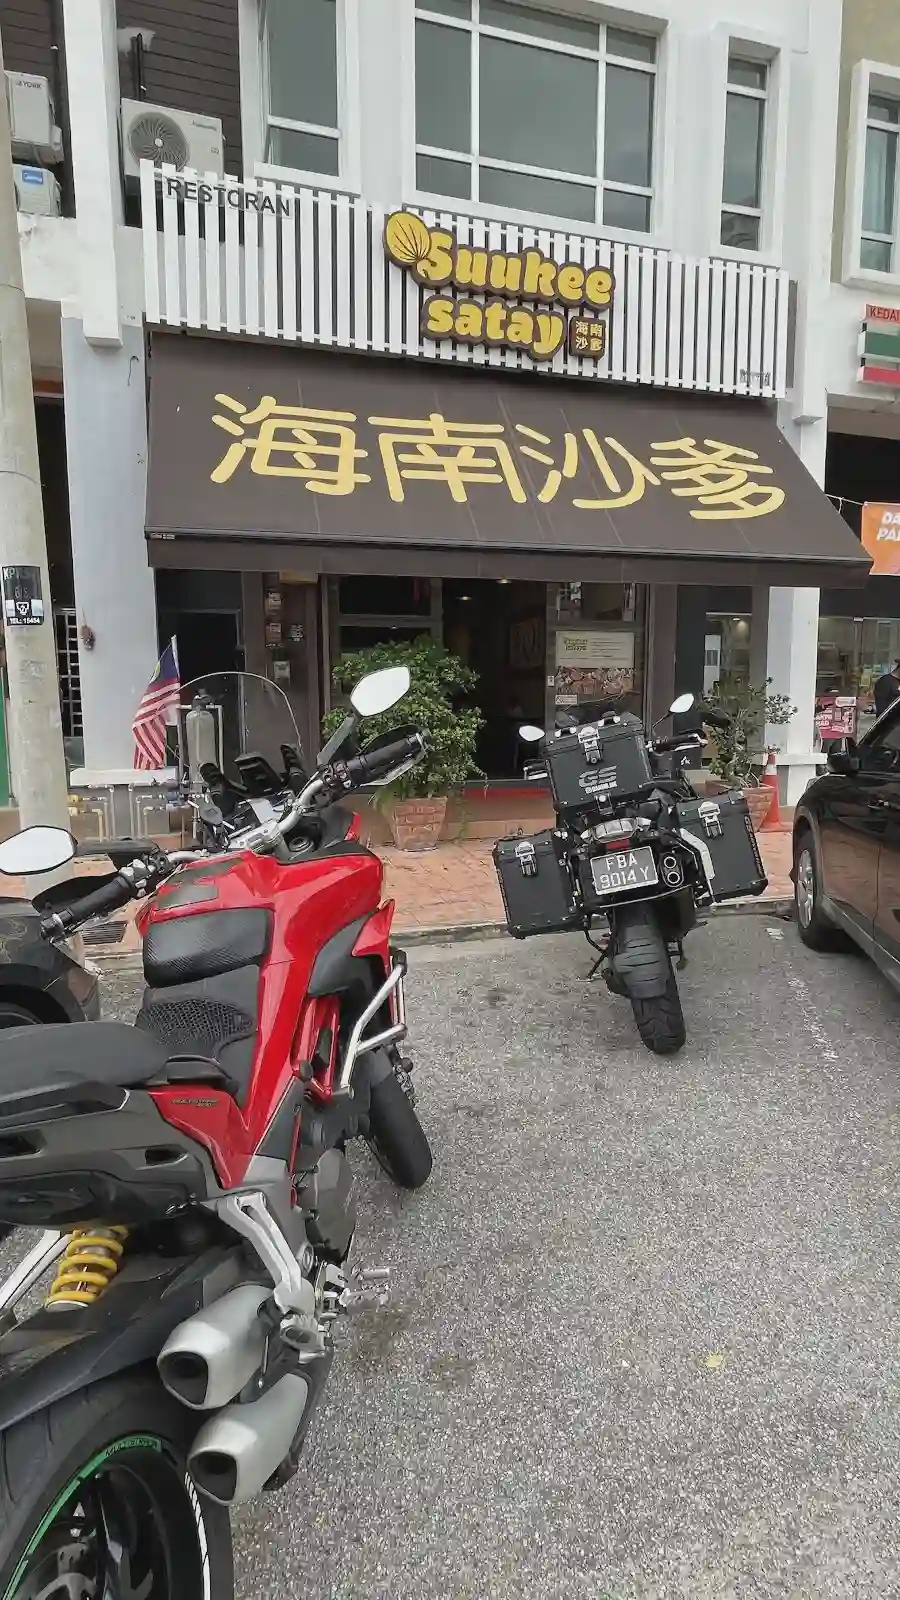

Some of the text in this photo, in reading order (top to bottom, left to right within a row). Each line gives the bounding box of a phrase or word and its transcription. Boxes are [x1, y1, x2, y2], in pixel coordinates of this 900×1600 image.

[166, 177, 290, 217] RESTORAN
[415, 230, 613, 305] Suukee
[426, 298, 563, 354] satay
[210, 393, 786, 520] 海南沙爹
[578, 765, 617, 788] GS
[600, 866, 649, 889] 9014 Y
[605, 852, 637, 871] FBA
